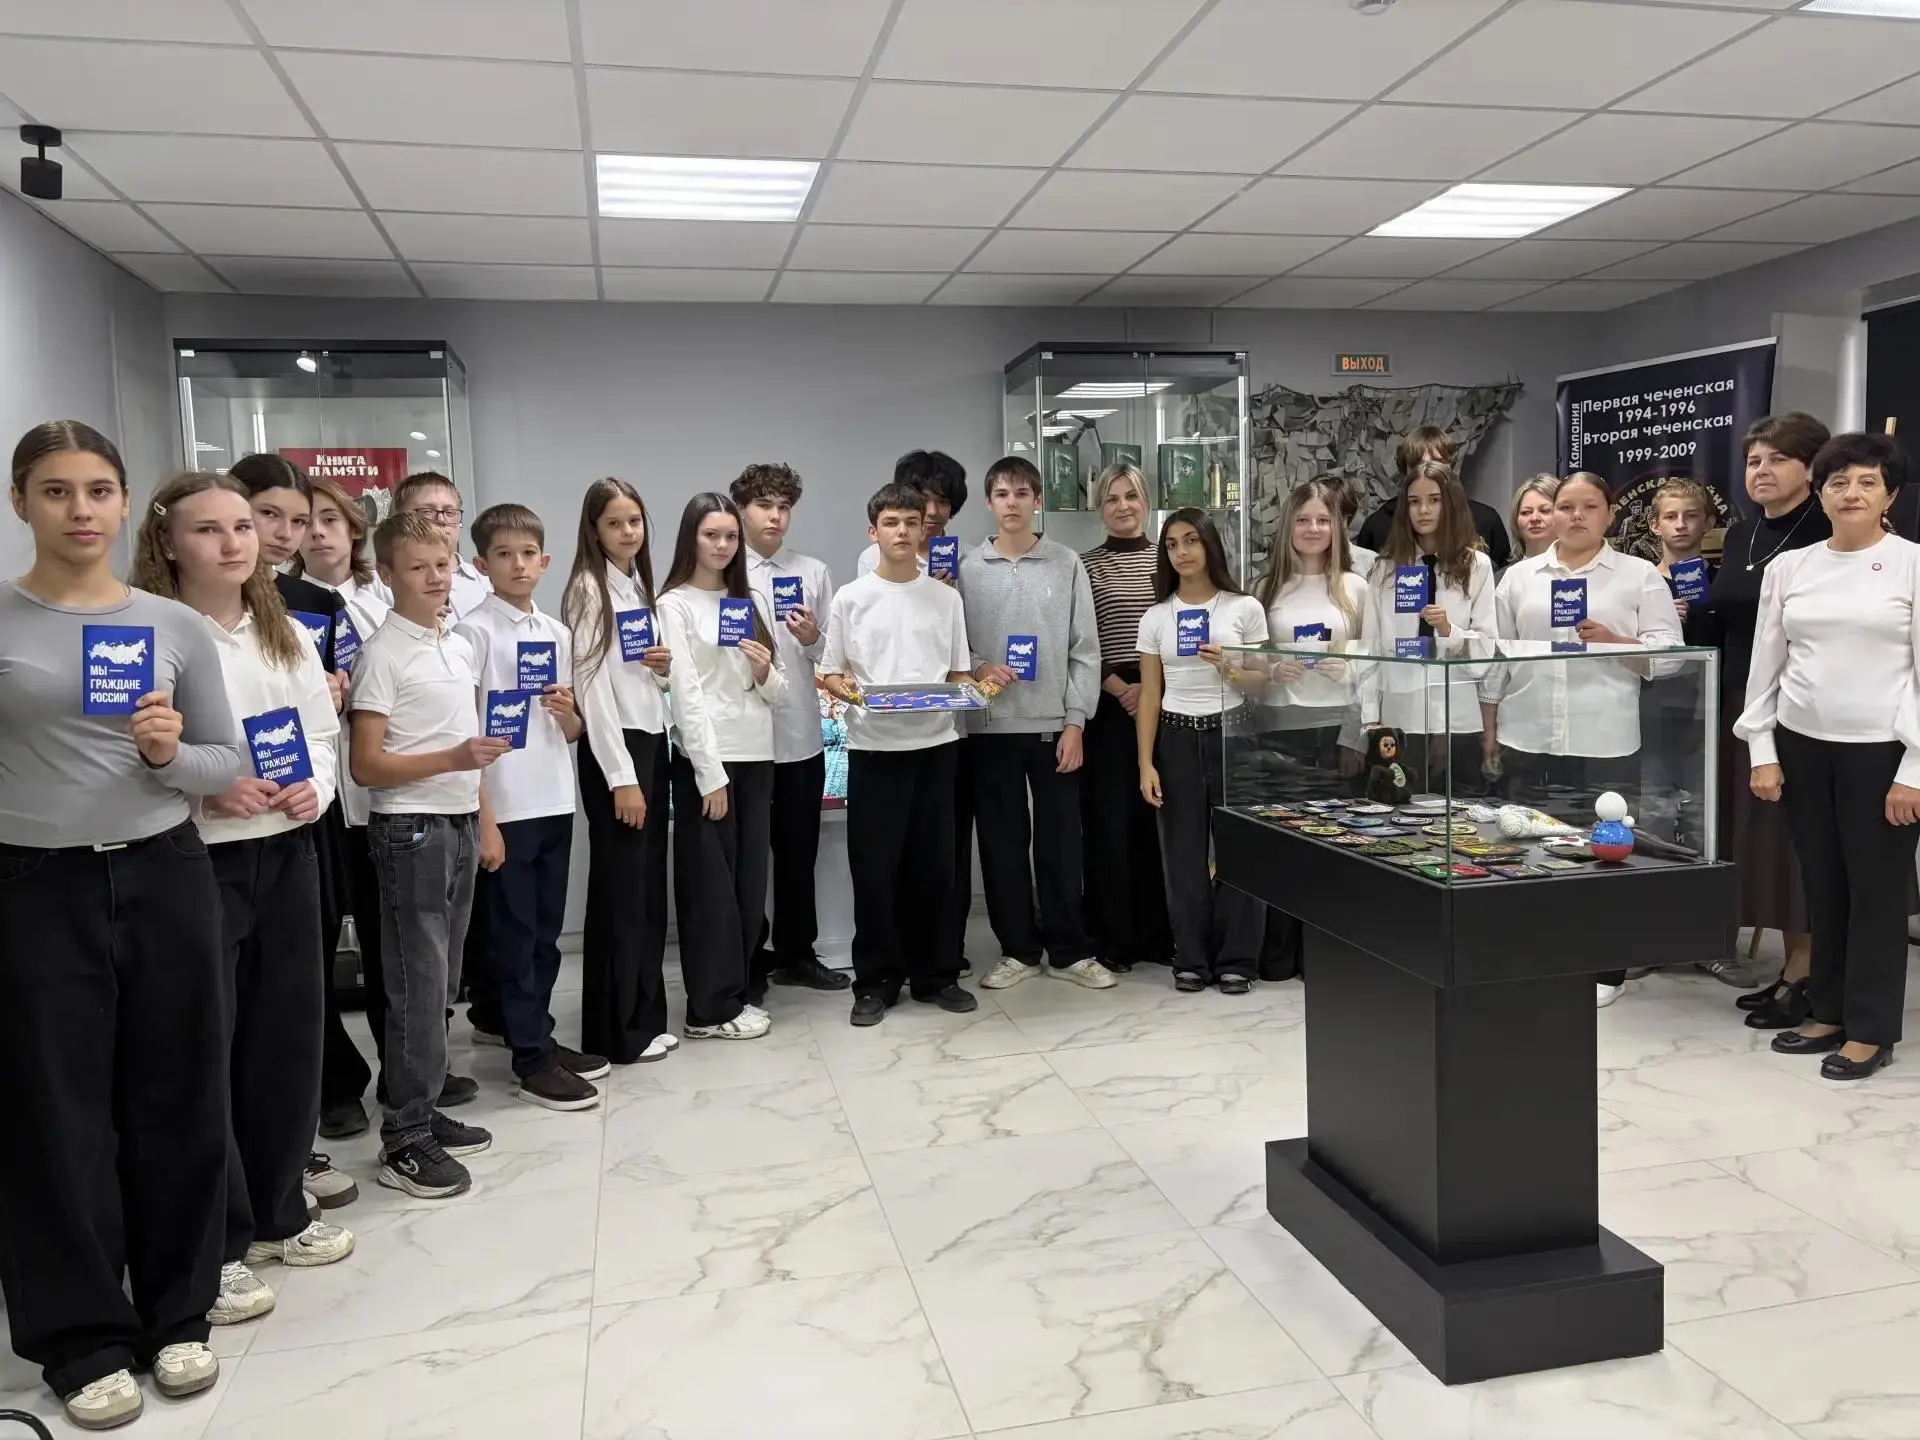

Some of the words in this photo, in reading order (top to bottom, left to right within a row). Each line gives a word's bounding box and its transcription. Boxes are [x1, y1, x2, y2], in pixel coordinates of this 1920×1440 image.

[1342, 356, 1385, 372] ВЫХОД
[1583, 394, 1639, 413] Первая
[1643, 379, 1734, 402] чеченская
[1618, 400, 1696, 424] 1994-1996
[1569, 403, 1580, 468] Кампания
[1583, 428, 1638, 445] Вторая
[1642, 414, 1733, 436] чеченская
[1618, 441, 1697, 464] 1999-2009
[308, 466, 379, 476] ПАМЯТИ
[1613, 477, 1679, 511] ЕНСКА
[90, 665, 108, 676] МЫ
[90, 679, 141, 690] ГРАЖДАНЕ
[90, 692, 129, 702] РОССИИ!
[490, 726, 521, 735] ГРАЖДАНЕ
[257, 749, 272, 760] МЫ
[260, 753, 300, 770] ГРАЖДАНЕ
[263, 766, 294, 780] РОССИИ!
